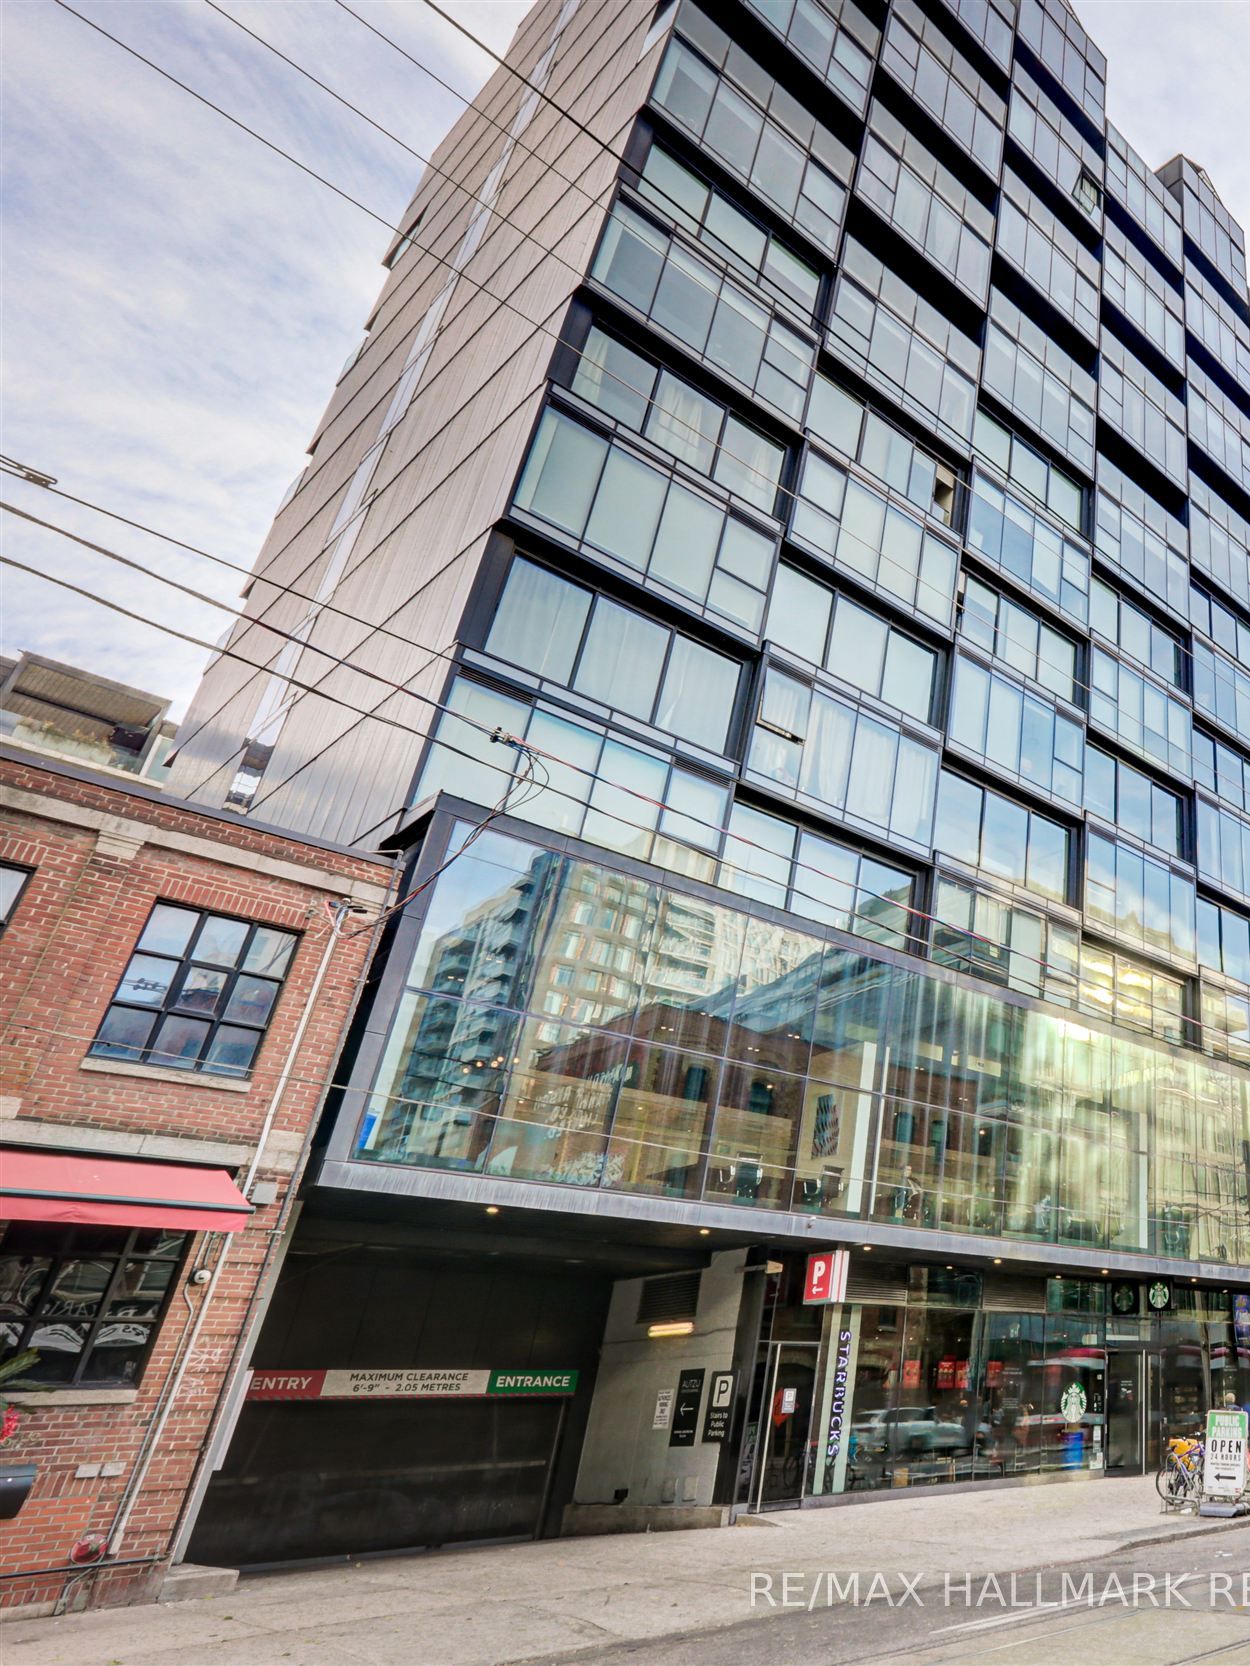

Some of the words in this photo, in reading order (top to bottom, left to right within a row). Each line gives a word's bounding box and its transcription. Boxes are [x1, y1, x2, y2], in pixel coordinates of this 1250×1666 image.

[812, 1260, 826, 1285] P
[350, 1372, 403, 1382] MAXIMUM
[406, 1372, 469, 1381] CLEARANCE
[495, 1375, 571, 1388] ENTRANCE
[250, 1376, 313, 1391] ENTRY
[395, 1383, 418, 1392] 2.05
[420, 1383, 461, 1392] METRES
[716, 1379, 729, 1404] P
[828, 1331, 852, 1456] STARBUCKS
[710, 1411, 723, 1420] Stairs
[710, 1420, 725, 1428] Public
[707, 1429, 725, 1438] Parking
[1211, 1439, 1242, 1454] OPEN
[1221, 1453, 1241, 1462] HOURS
